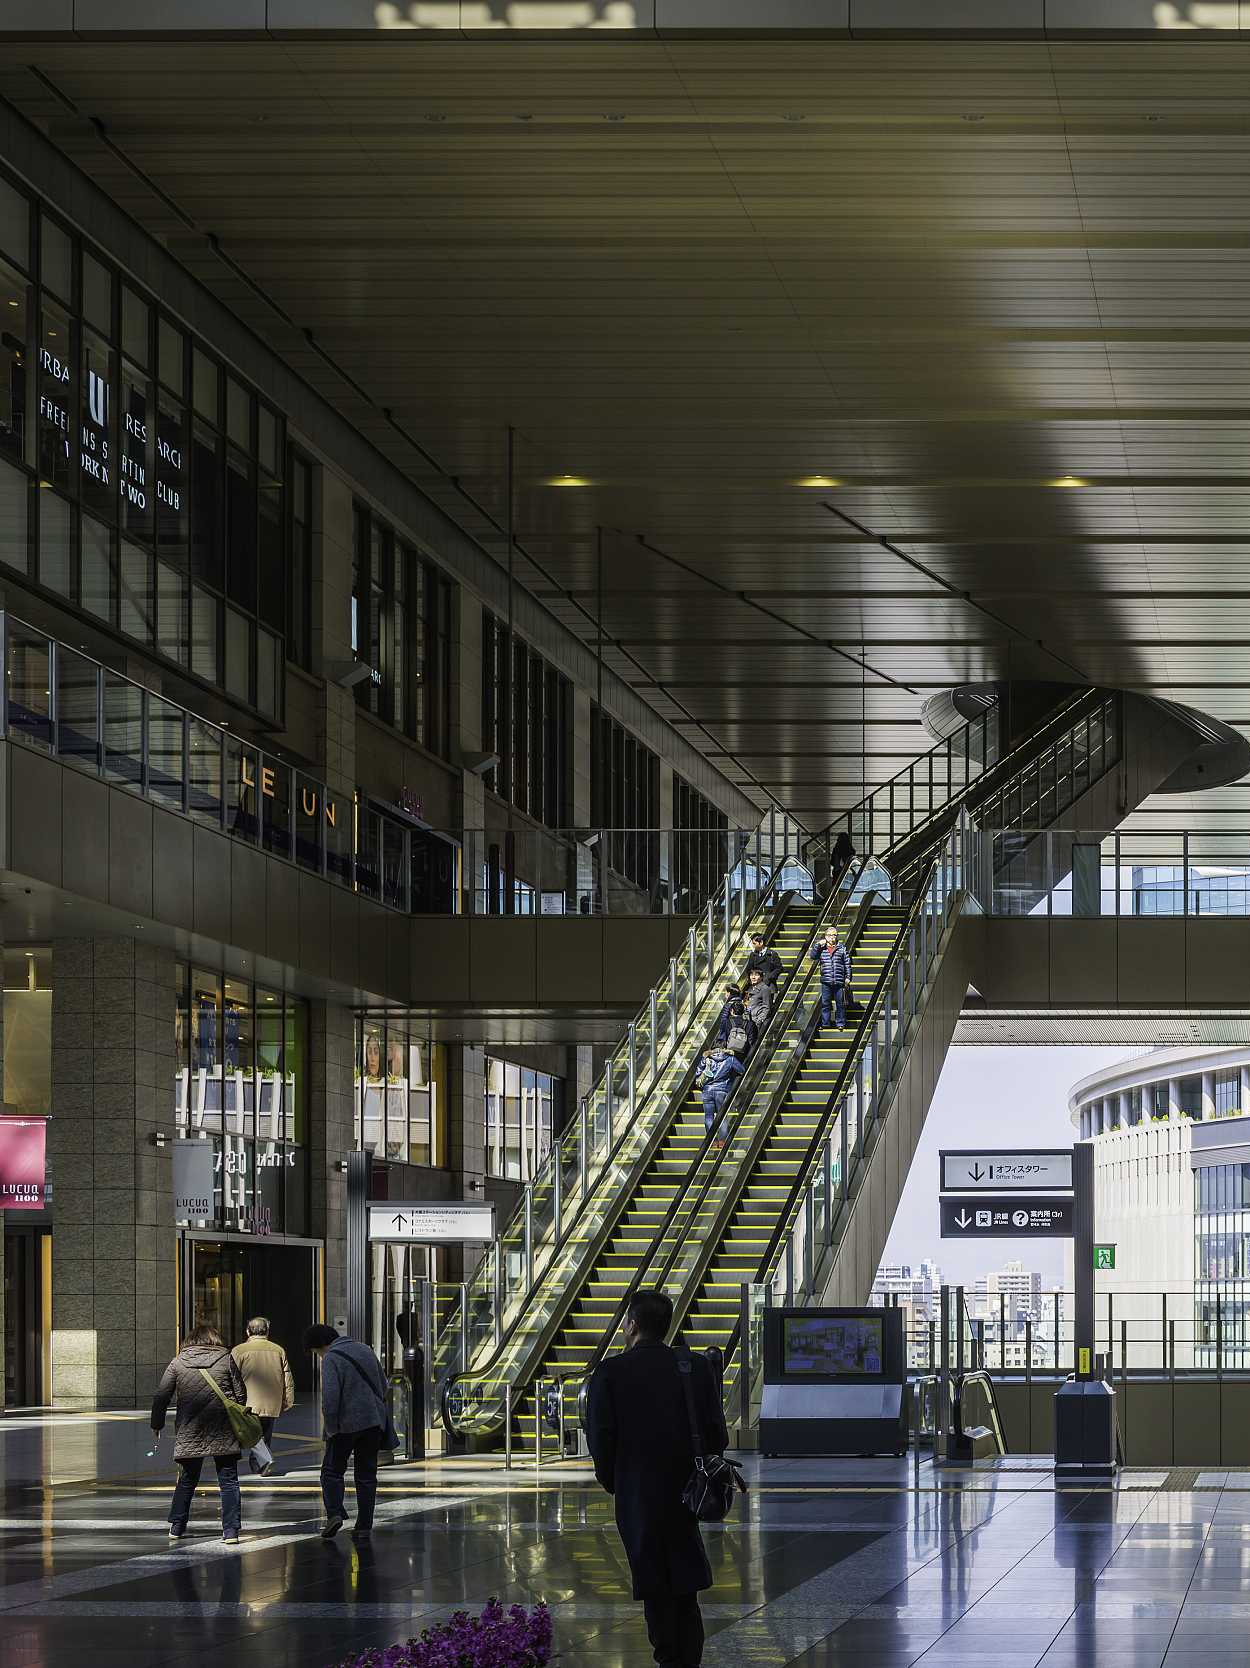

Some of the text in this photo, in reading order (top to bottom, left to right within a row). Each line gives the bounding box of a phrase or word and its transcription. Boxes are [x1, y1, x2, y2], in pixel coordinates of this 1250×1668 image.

[39, 348, 70, 382] RBA
[157, 480, 180, 510] CLUB
[996, 1165, 1048, 1173] オフィスタワー
